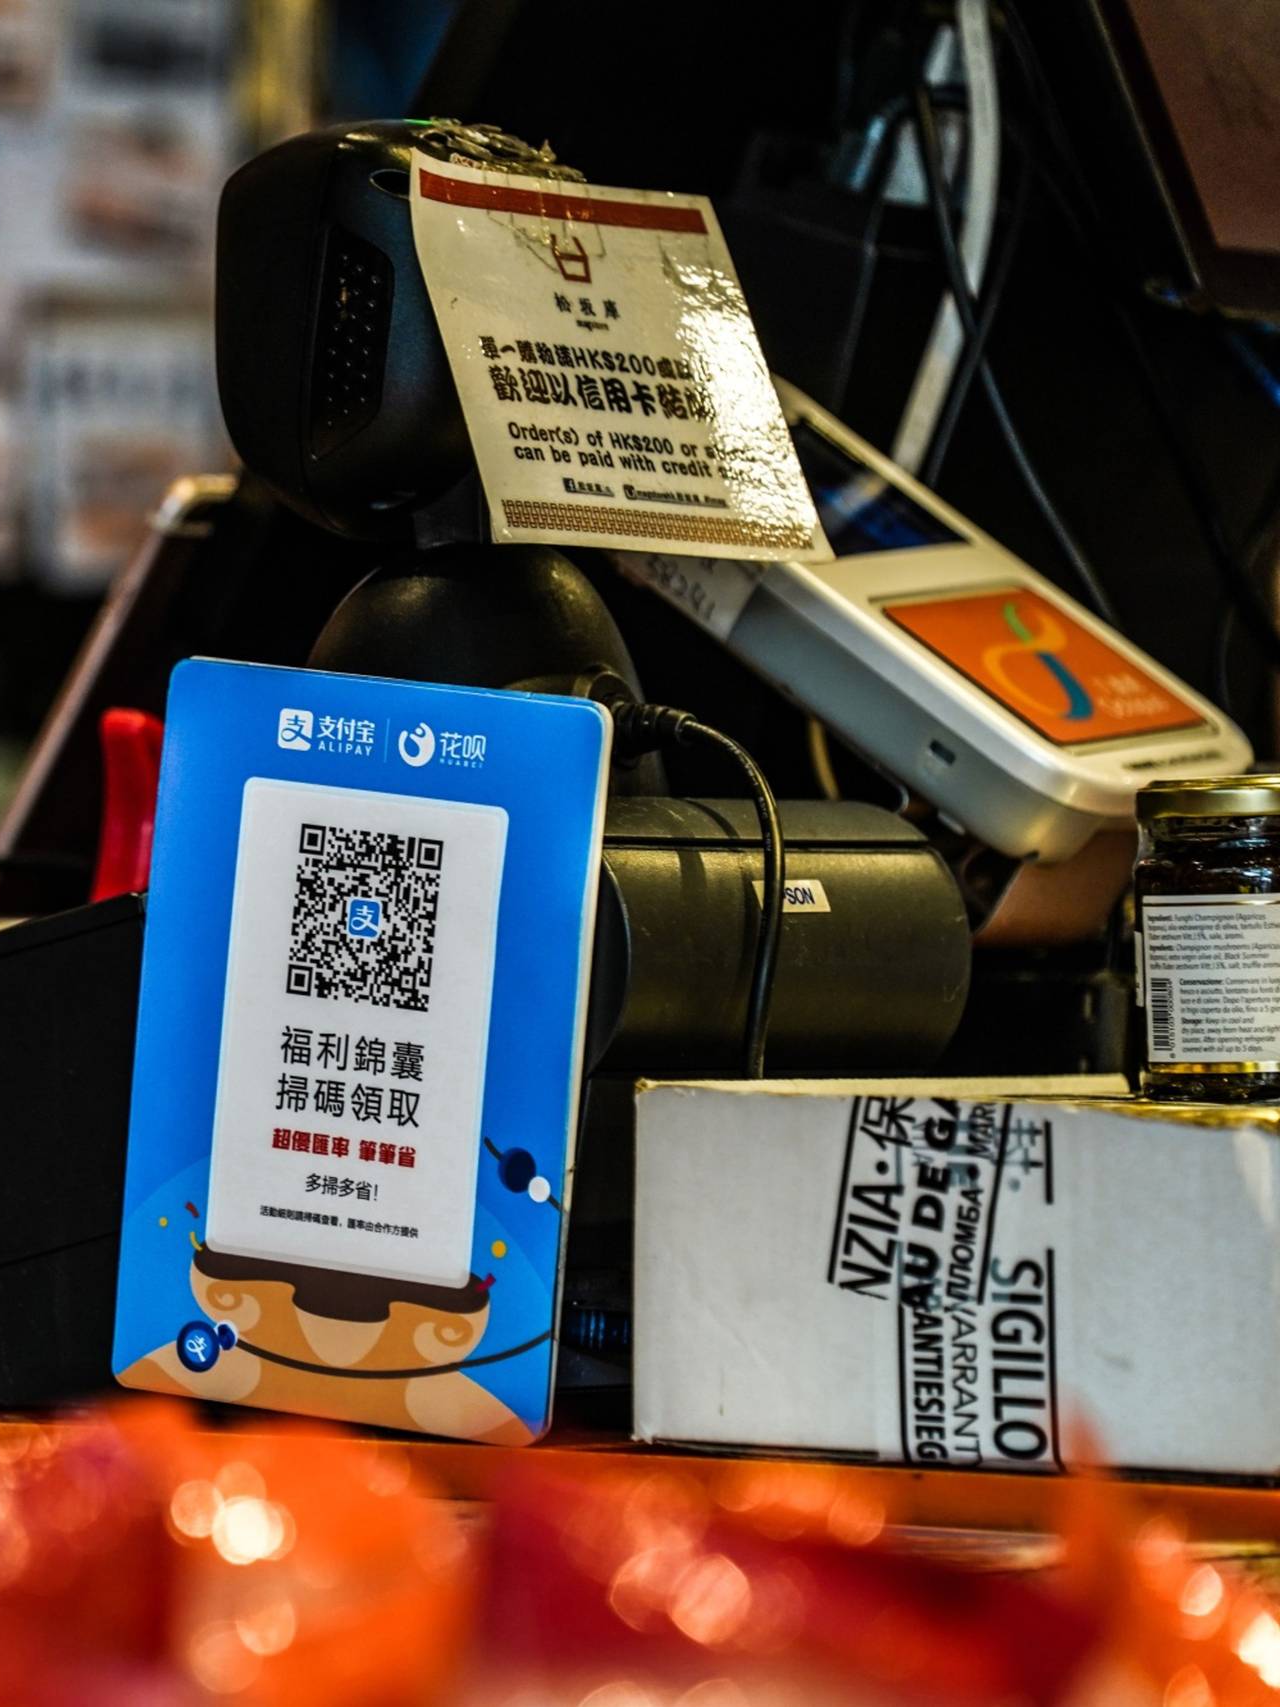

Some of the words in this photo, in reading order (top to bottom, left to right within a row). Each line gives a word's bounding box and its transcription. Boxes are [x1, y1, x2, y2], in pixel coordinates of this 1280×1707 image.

[507, 421, 579, 446] Order(s)
[586, 430, 604, 447] of
[680, 444, 699, 458] or
[514, 445, 546, 461] can
[552, 443, 571, 463] be
[579, 449, 614, 468] paid
[619, 453, 656, 472] with
[661, 459, 712, 477] credit
[317, 715, 376, 744] 支付宝
[440, 731, 487, 762] 花呗
[318, 740, 373, 758] ALIPAY
[280, 1025, 424, 1082] 福利錦囊
[275, 1072, 420, 1128] 掃碼領取
[272, 1128, 350, 1157] 超優匯率
[359, 1140, 416, 1168] 筆筆省
[305, 1173, 379, 1201] 多掃多省!
[911, 1162, 951, 1232] DE
[990, 1256, 1048, 1461] SIGILLO
